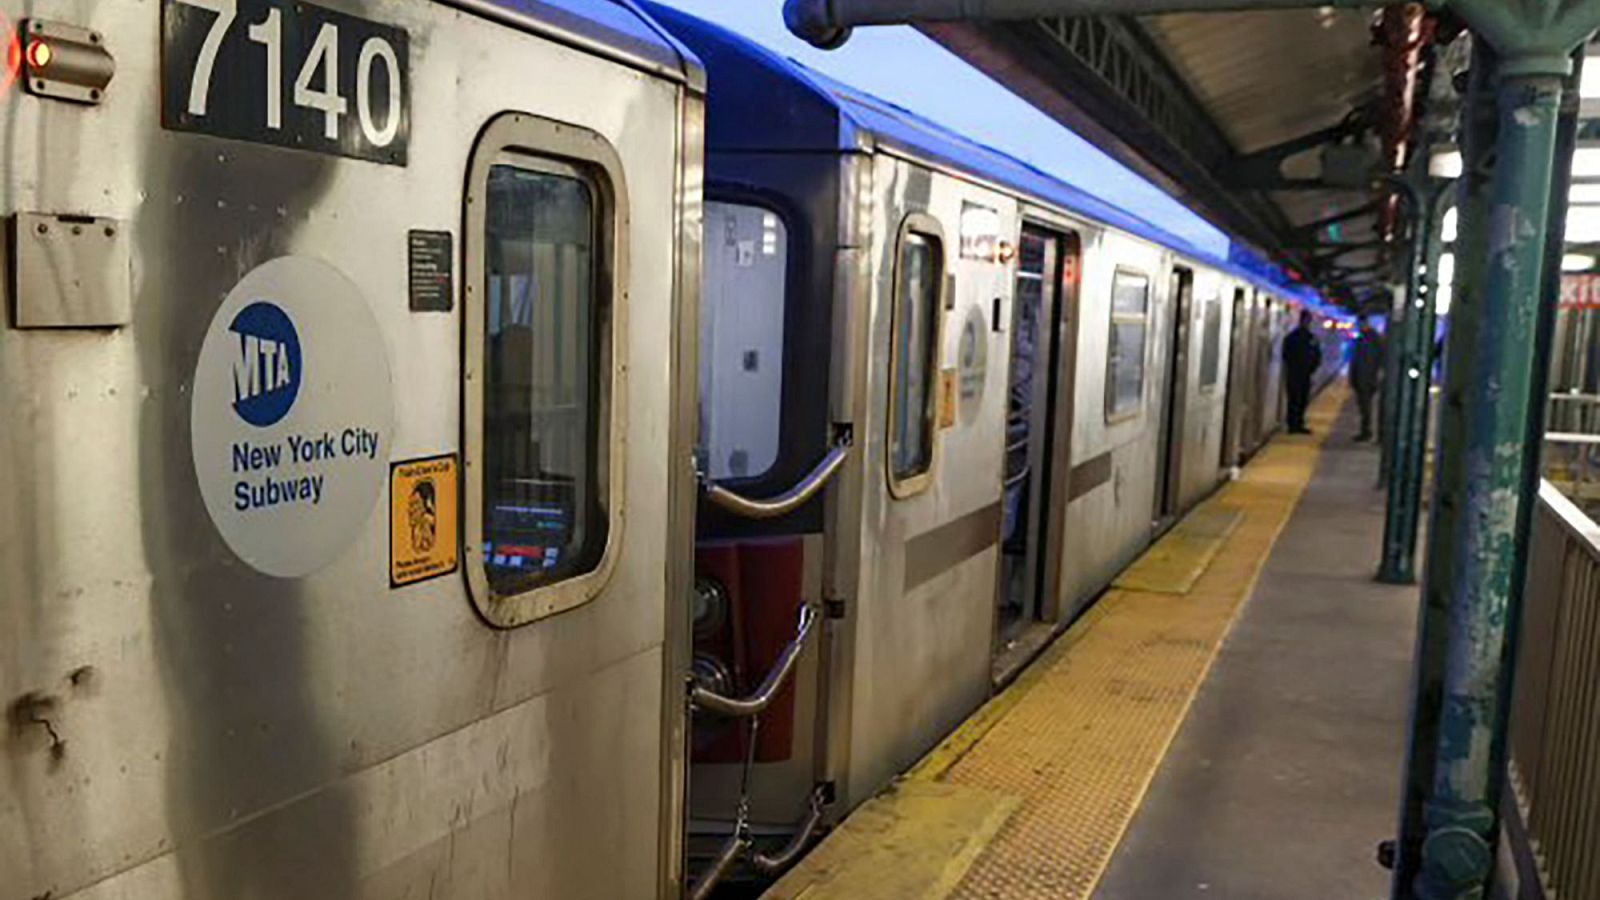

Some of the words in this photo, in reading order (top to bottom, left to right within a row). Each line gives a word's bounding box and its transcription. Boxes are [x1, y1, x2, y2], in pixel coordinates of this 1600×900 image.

[175, 0, 402, 147] 7140
[229, 331, 291, 402] MTA
[232, 442, 281, 472] New
[287, 432, 336, 463] York
[341, 427, 379, 460] City
[234, 474, 324, 511] Subway
